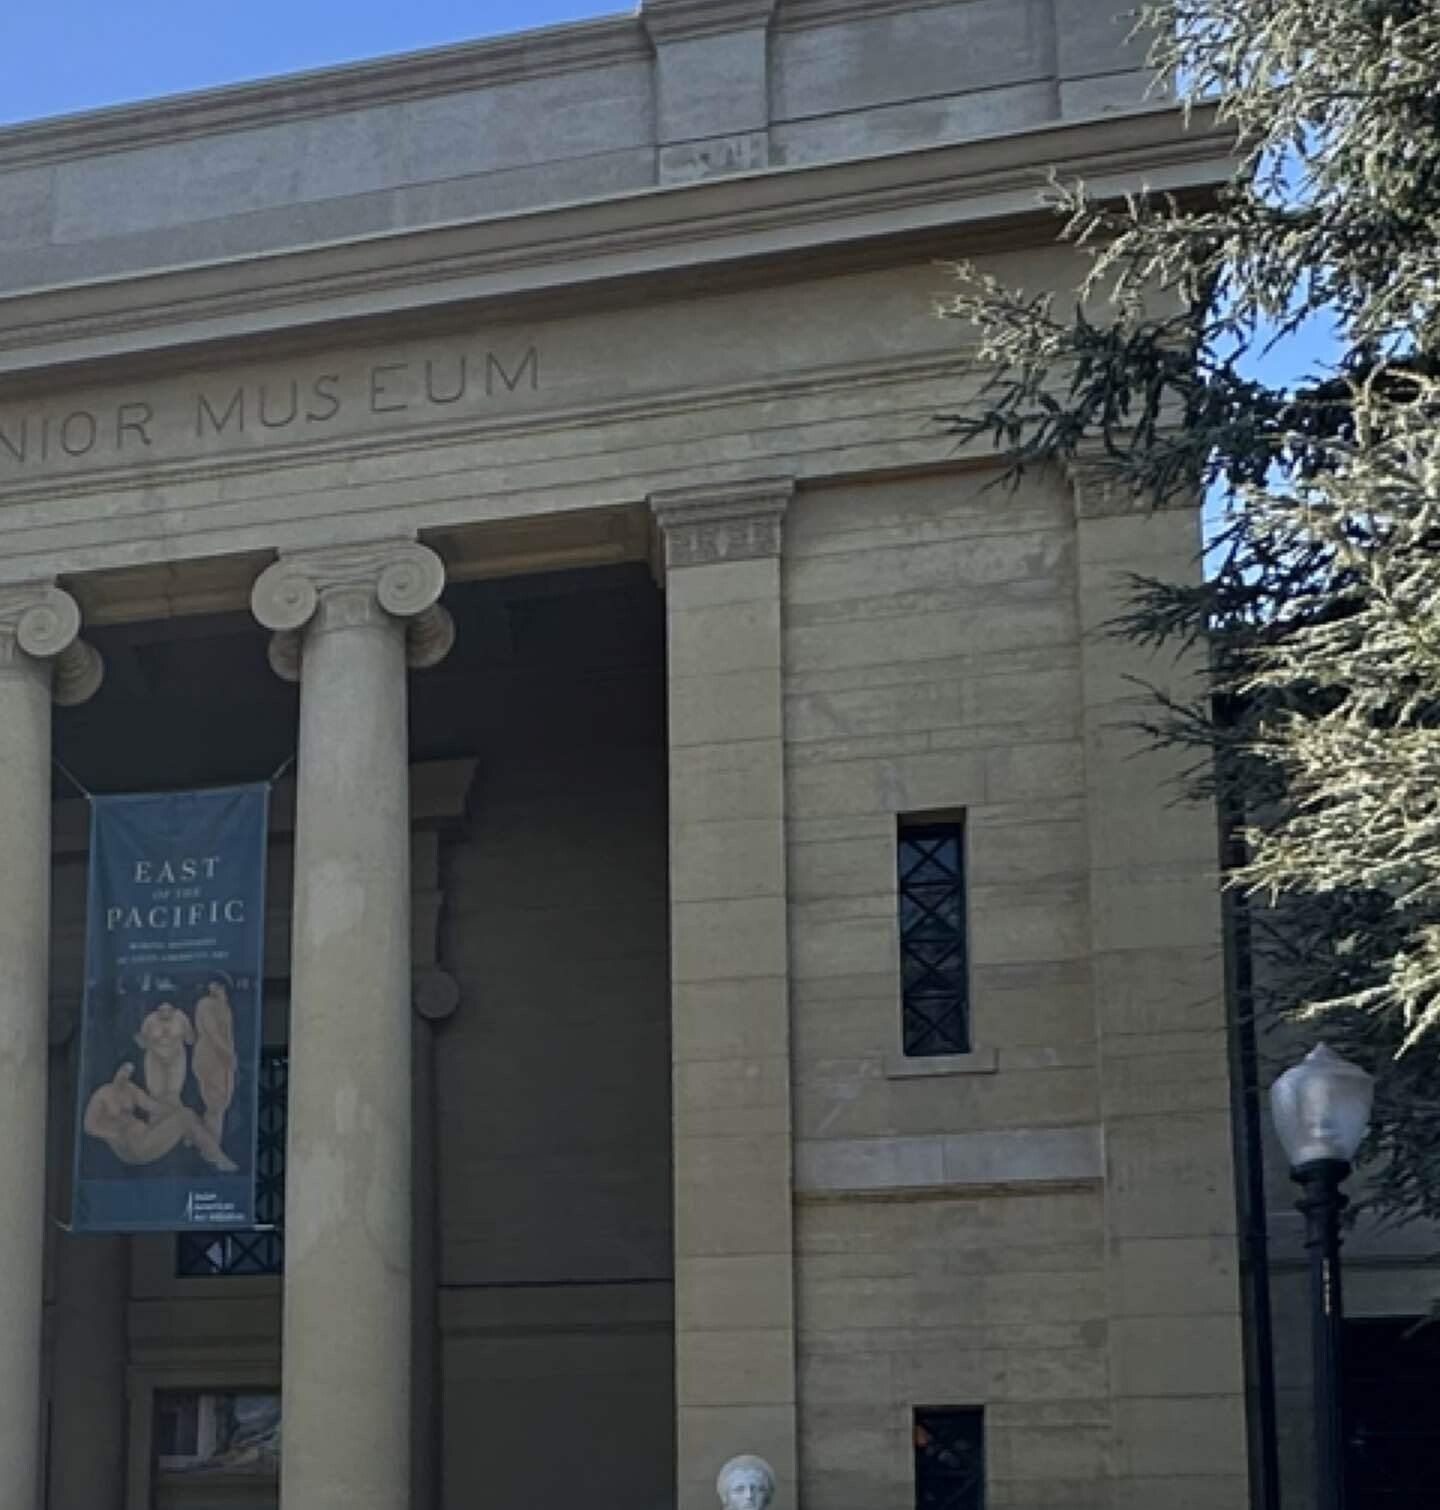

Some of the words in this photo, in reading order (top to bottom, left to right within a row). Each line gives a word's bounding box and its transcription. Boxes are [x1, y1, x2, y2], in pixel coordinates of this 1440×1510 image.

[194, 344, 540, 438] MUSEUM
[133, 855, 222, 884] EAST
[106, 899, 245, 931] PACIFIC
